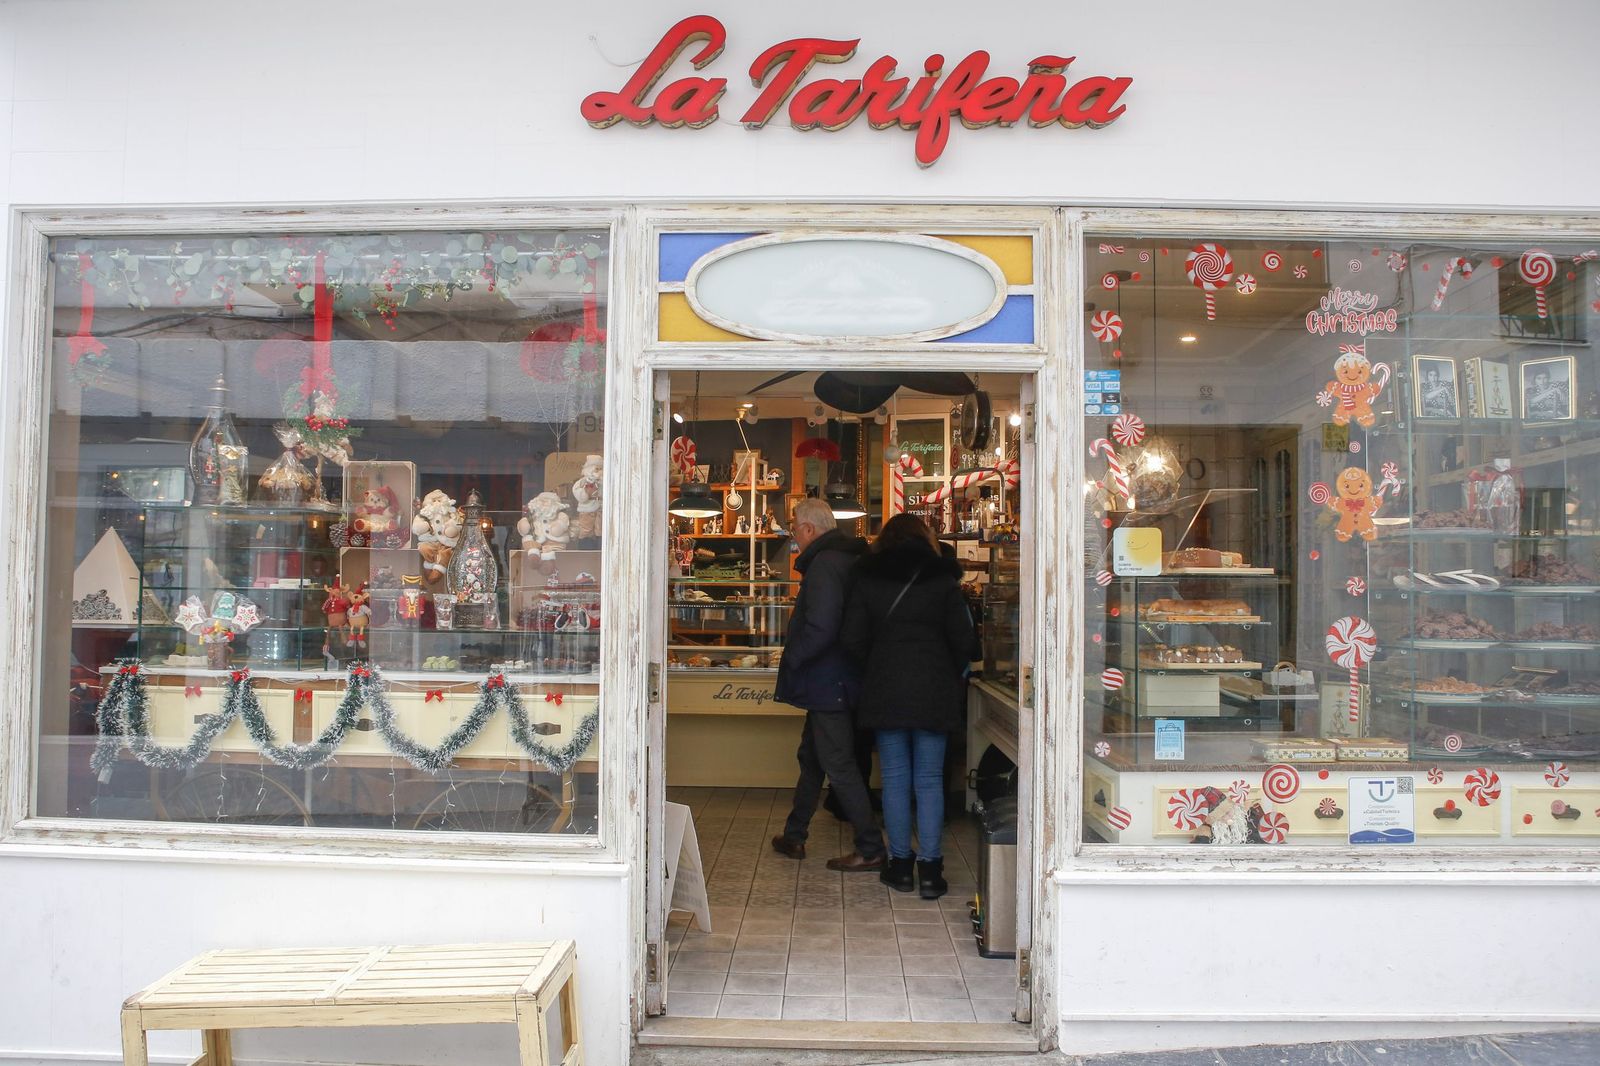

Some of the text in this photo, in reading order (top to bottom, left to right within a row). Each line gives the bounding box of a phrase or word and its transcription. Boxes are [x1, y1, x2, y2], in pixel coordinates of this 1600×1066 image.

[580, 14, 1133, 169] La Tarifeña
[1320, 286, 1379, 315] Merry
[712, 683, 775, 705] La Tarife
